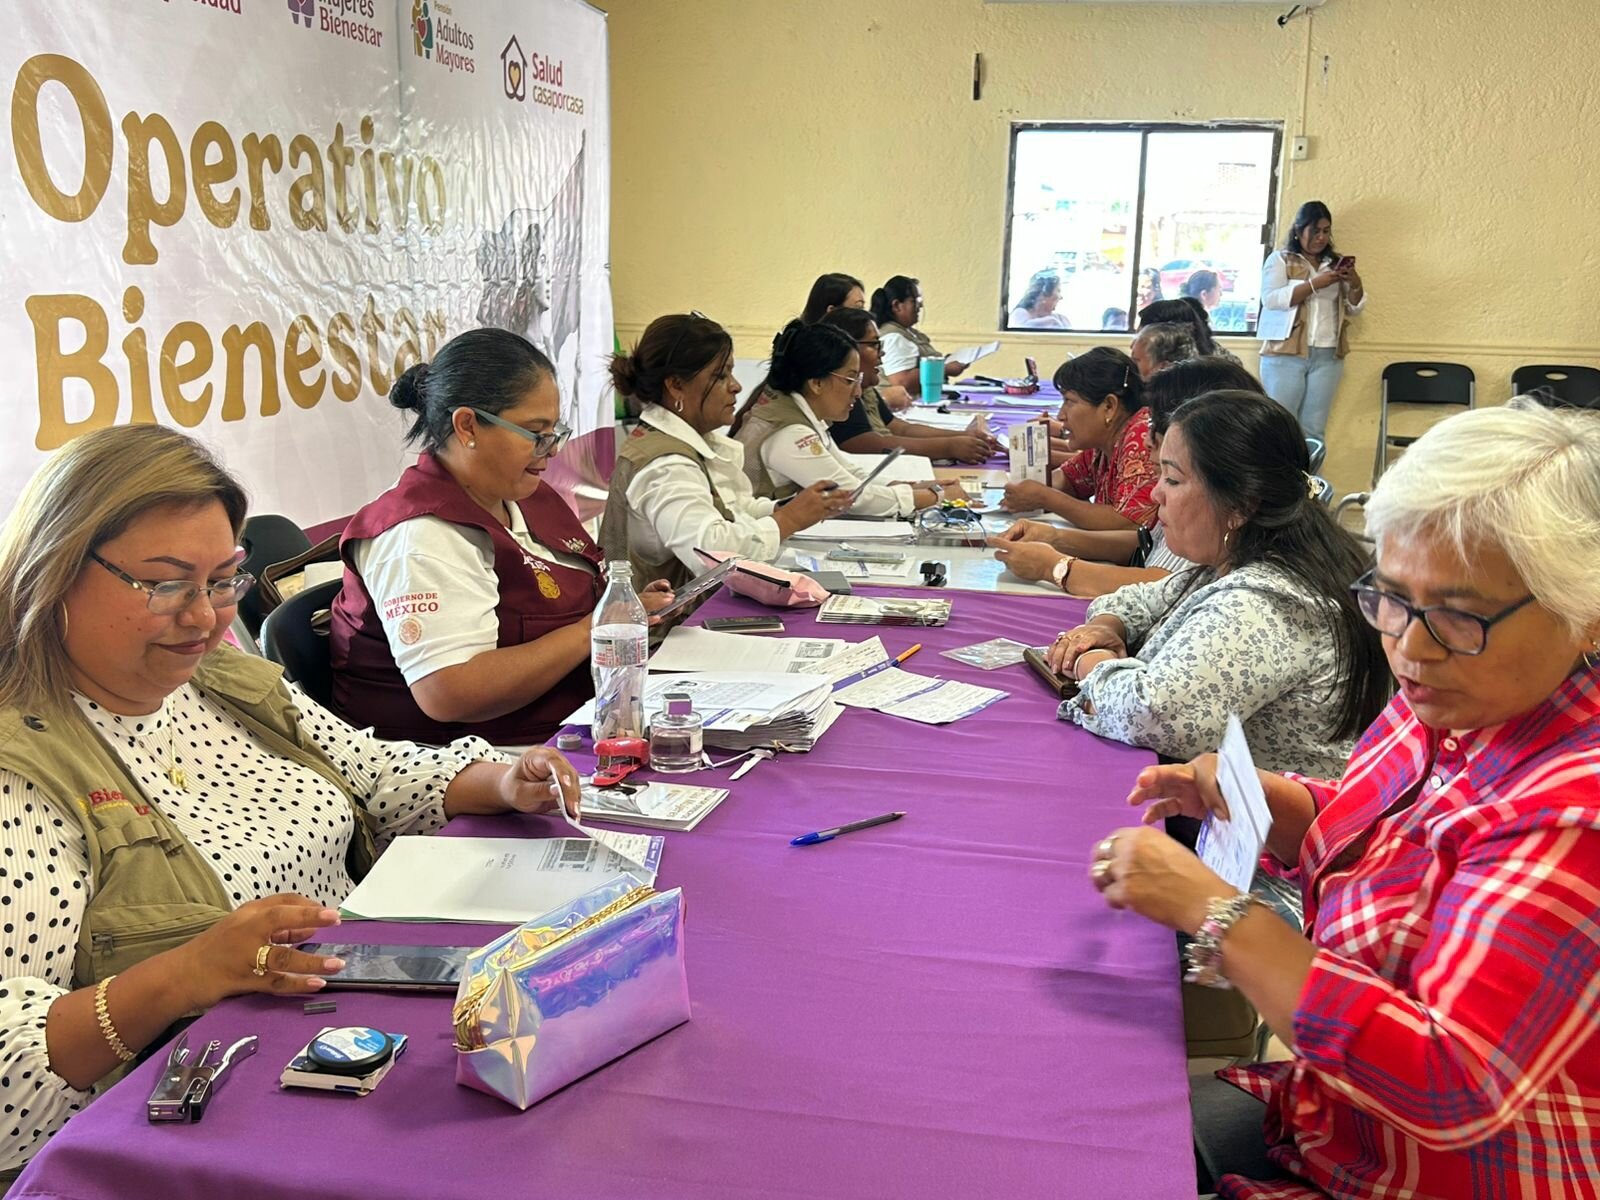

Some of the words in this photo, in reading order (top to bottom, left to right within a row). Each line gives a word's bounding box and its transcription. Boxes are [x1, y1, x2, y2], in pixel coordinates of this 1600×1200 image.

[319, 0, 374, 18] jeres
[319, 6, 383, 47] Bienestar
[436, 17, 474, 50] Adultos
[435, 42, 475, 73] Mayores
[532, 52, 563, 87] Salud
[532, 85, 584, 115] casaporcasa
[11, 53, 446, 265] Operativo
[25, 286, 447, 451] Bienestar
[383, 593, 424, 607] GOBIERNO
[425, 592, 438, 600] DE
[386, 602, 439, 620] MÉXICO
